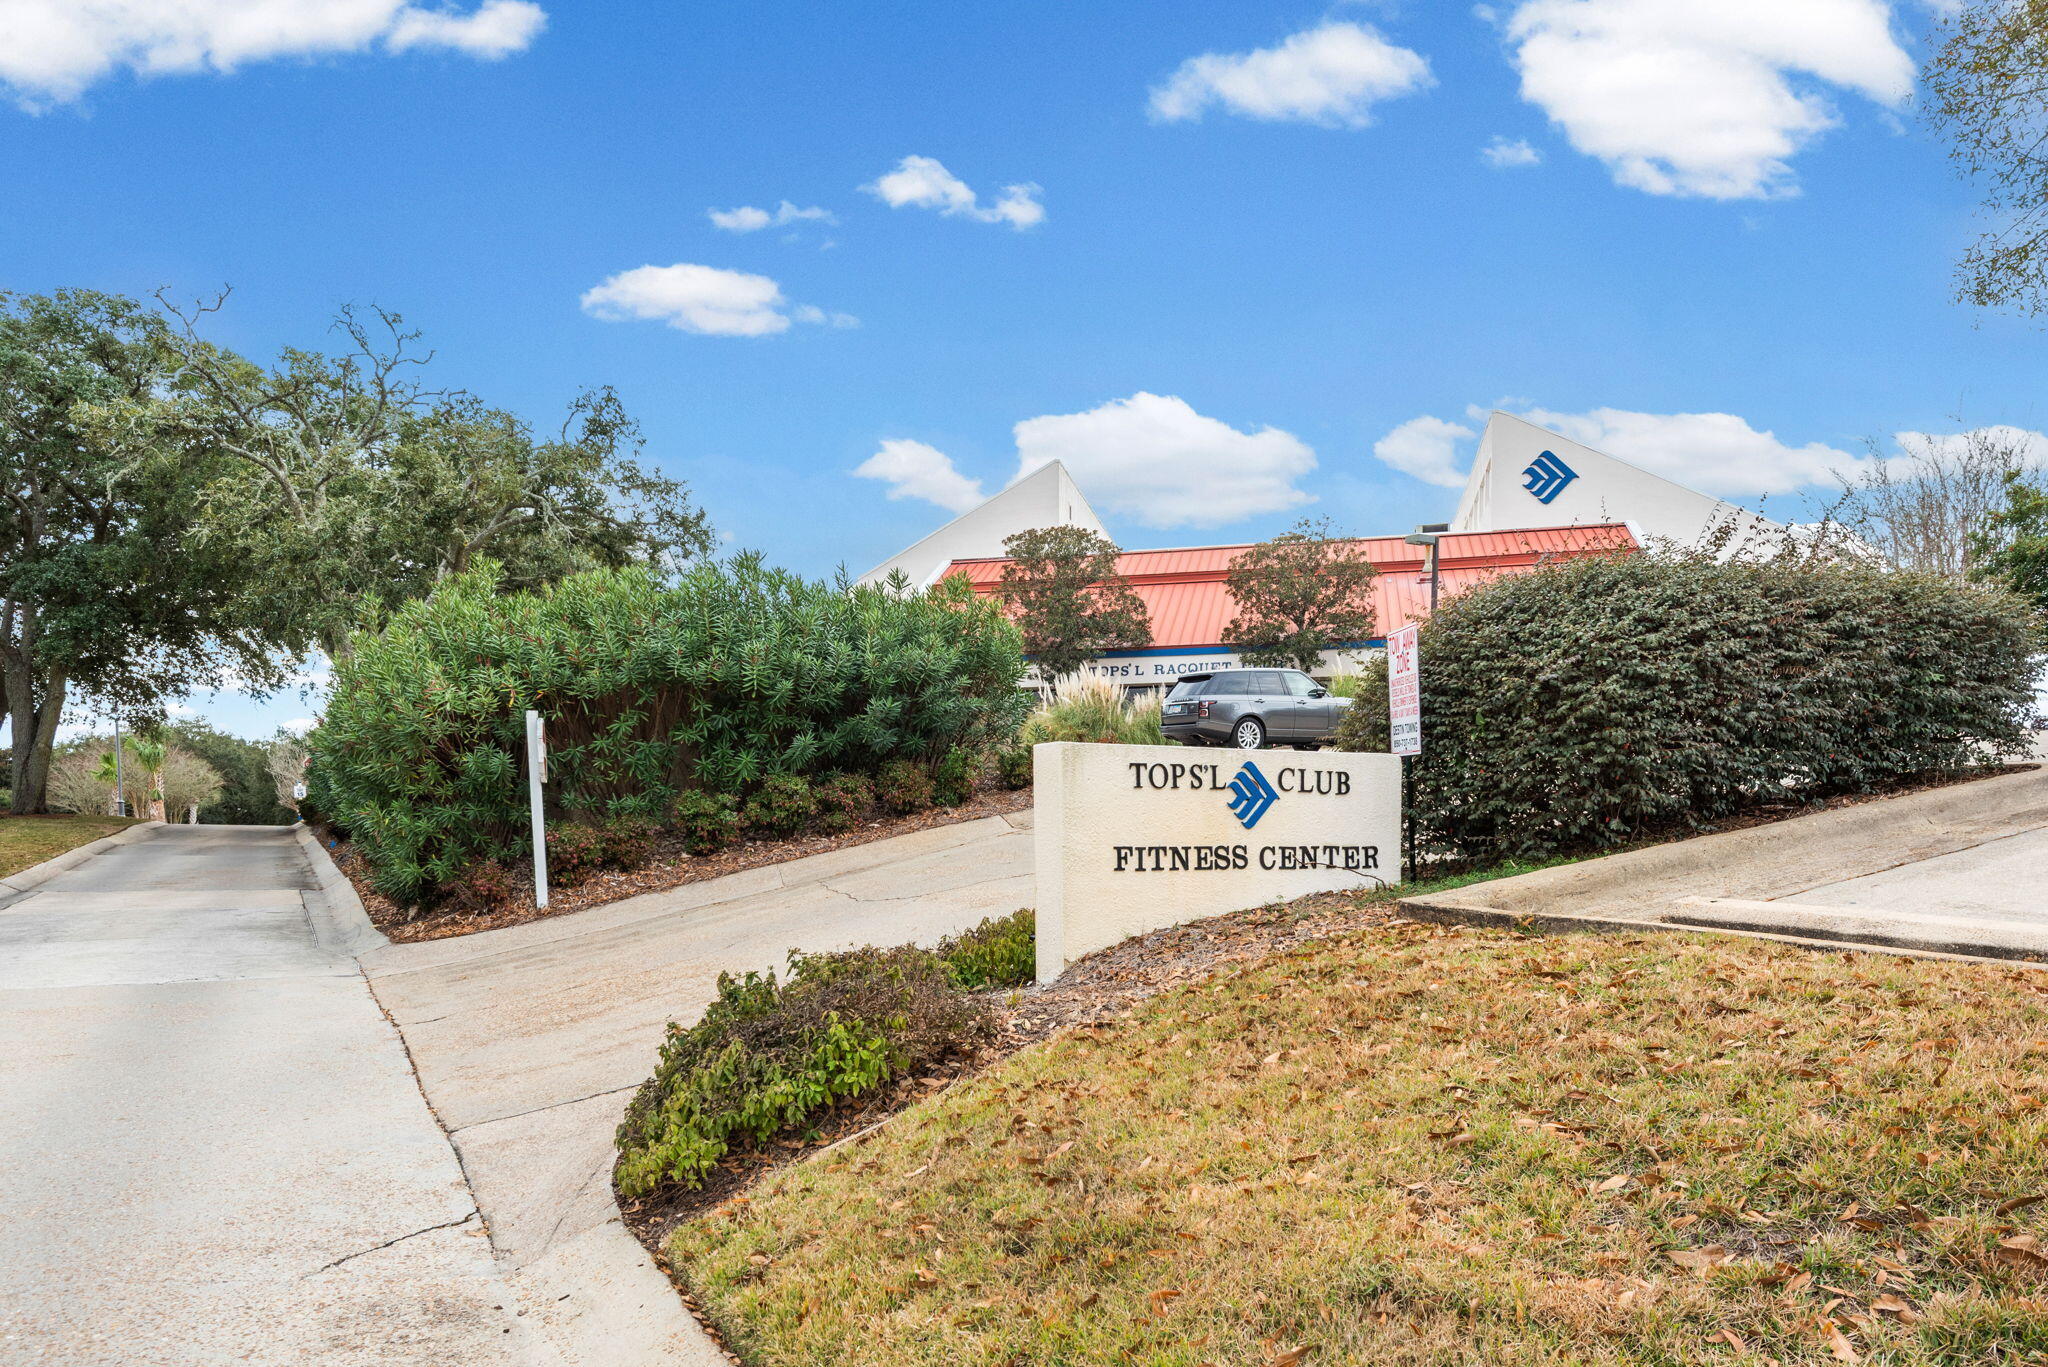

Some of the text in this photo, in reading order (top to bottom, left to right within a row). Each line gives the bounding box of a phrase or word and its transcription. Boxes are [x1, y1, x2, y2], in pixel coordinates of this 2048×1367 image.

[1154, 661, 1232, 675] RACQUET
[1129, 763, 1351, 795] TOPS'L CLUB
[1113, 845, 1379, 872] FITNESS CENTER
